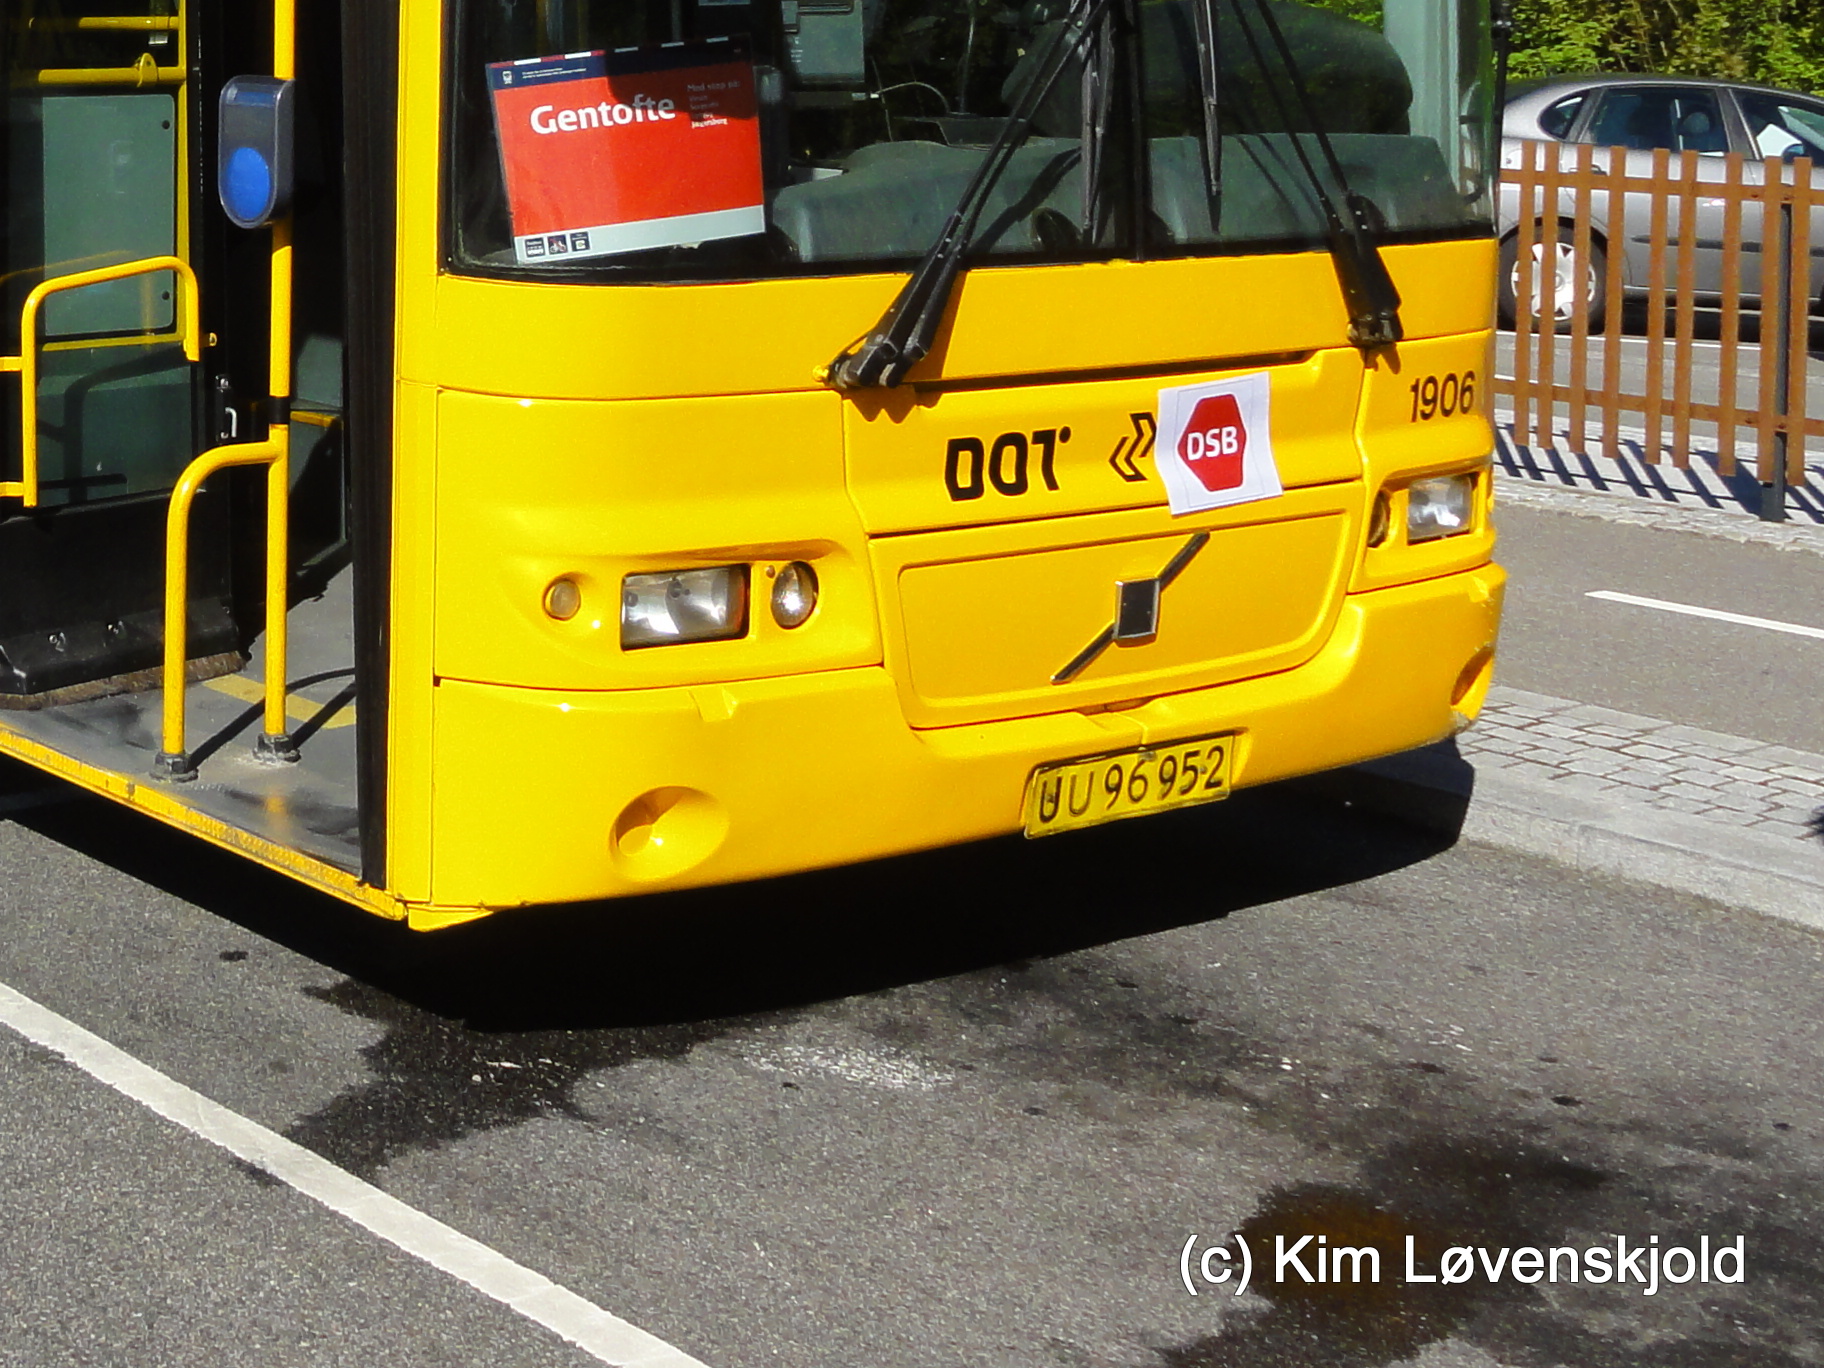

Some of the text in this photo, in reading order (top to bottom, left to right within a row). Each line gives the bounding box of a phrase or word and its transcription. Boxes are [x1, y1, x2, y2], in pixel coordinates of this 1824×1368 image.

[530, 93, 676, 135] Gentofte
[1410, 370, 1476, 423] 1906
[944, 426, 1071, 502] DOT
[1187, 425, 1239, 461] DSB
